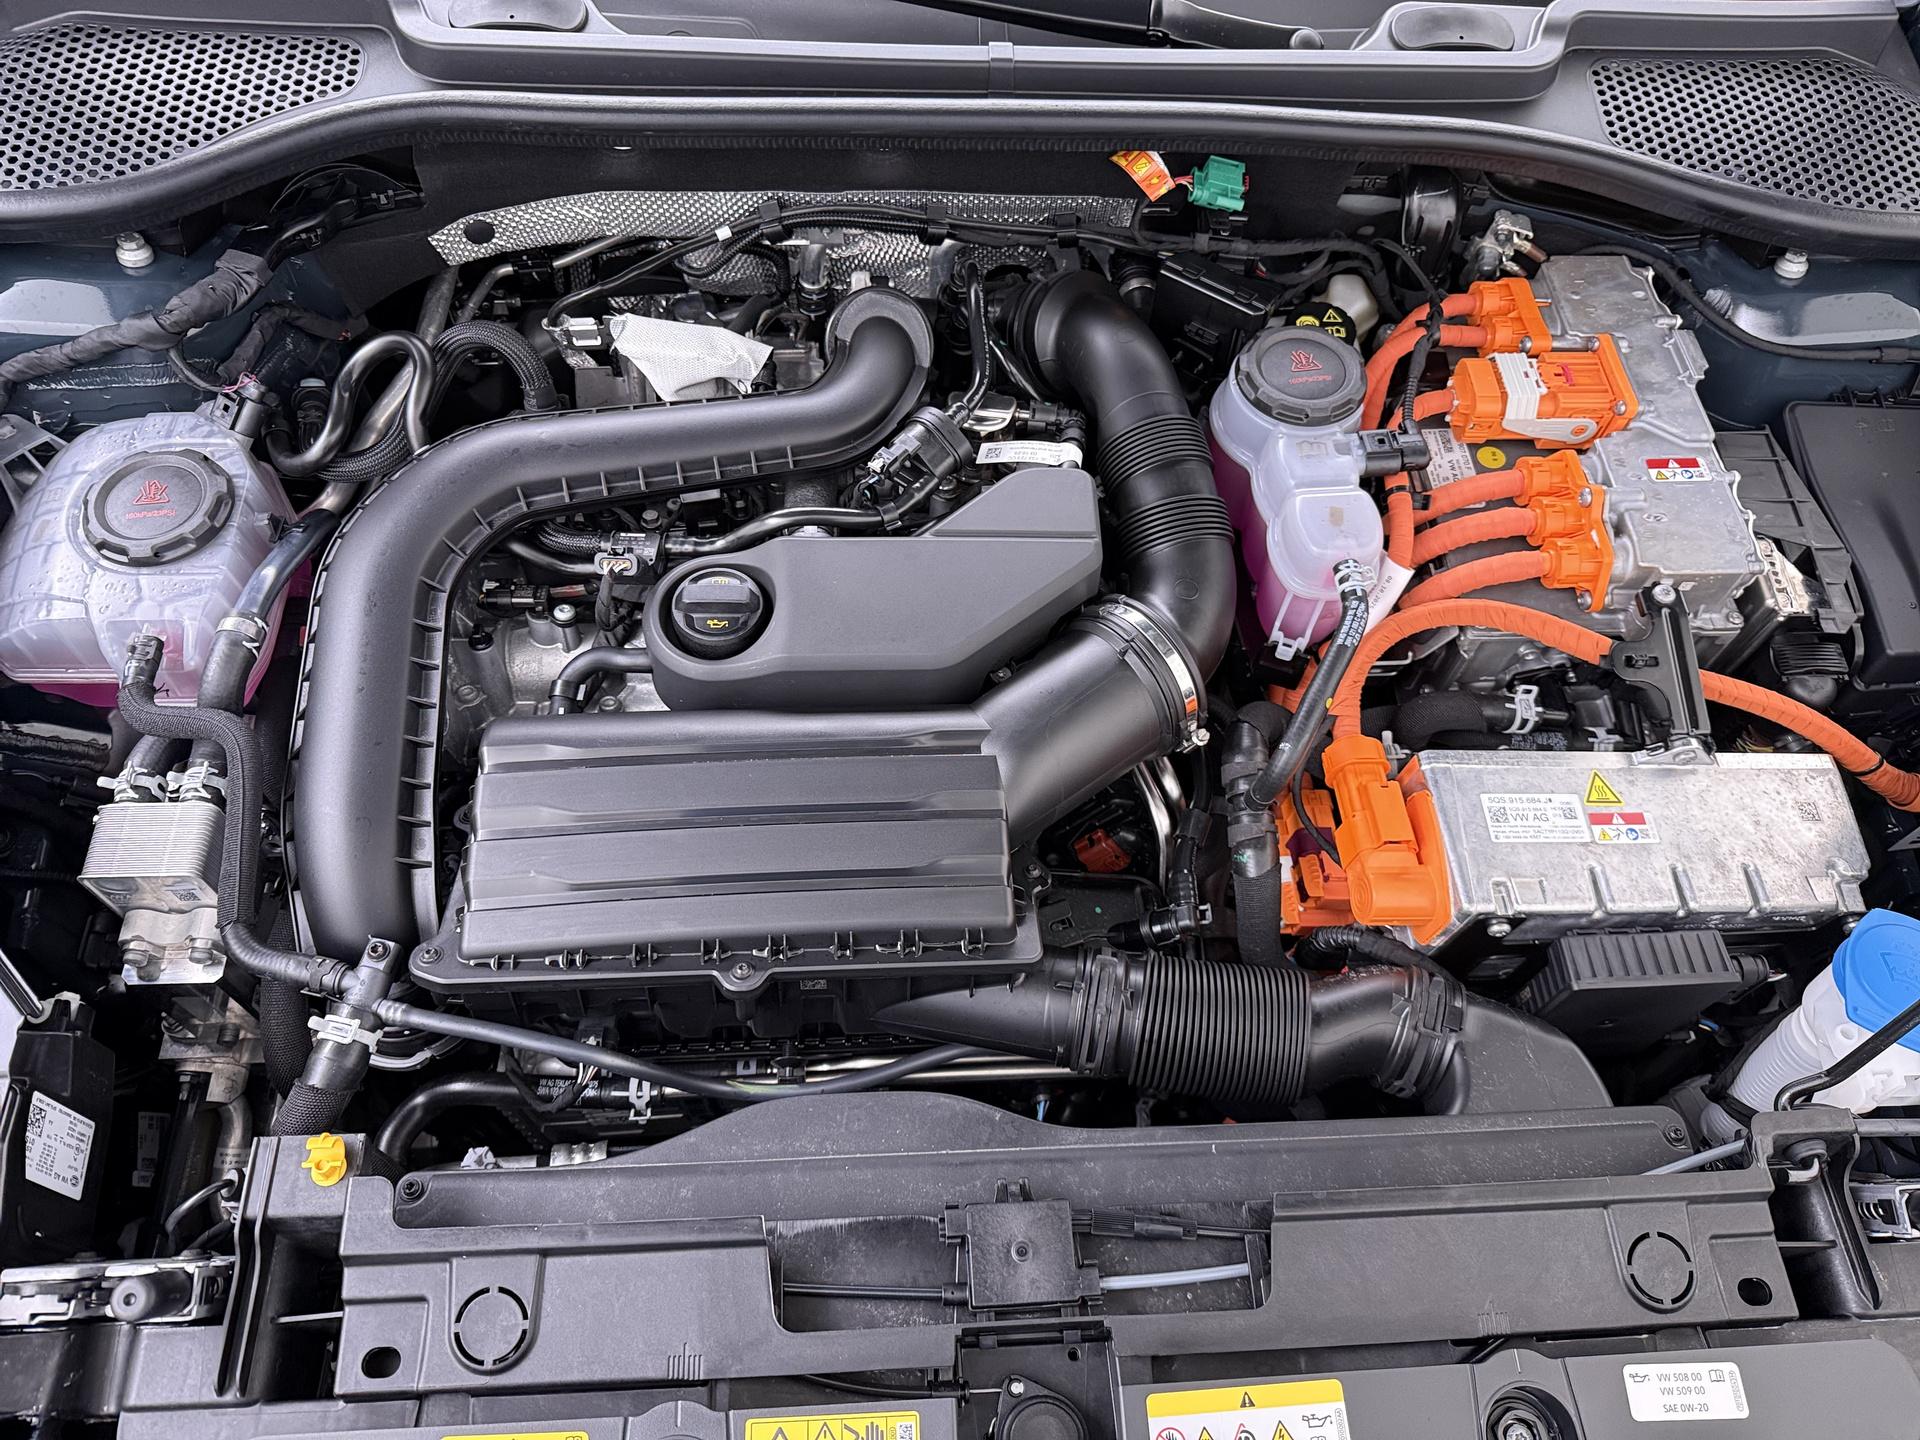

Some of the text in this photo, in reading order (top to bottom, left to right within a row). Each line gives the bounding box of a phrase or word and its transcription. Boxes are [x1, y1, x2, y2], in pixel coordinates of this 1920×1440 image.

[1510, 812, 1550, 822] VW AG
[1656, 1372, 1703, 1382] VW 508 00
[1660, 1385, 1706, 1396] VW 509 00
[1663, 1403, 1709, 1413] SAE 0W-20
